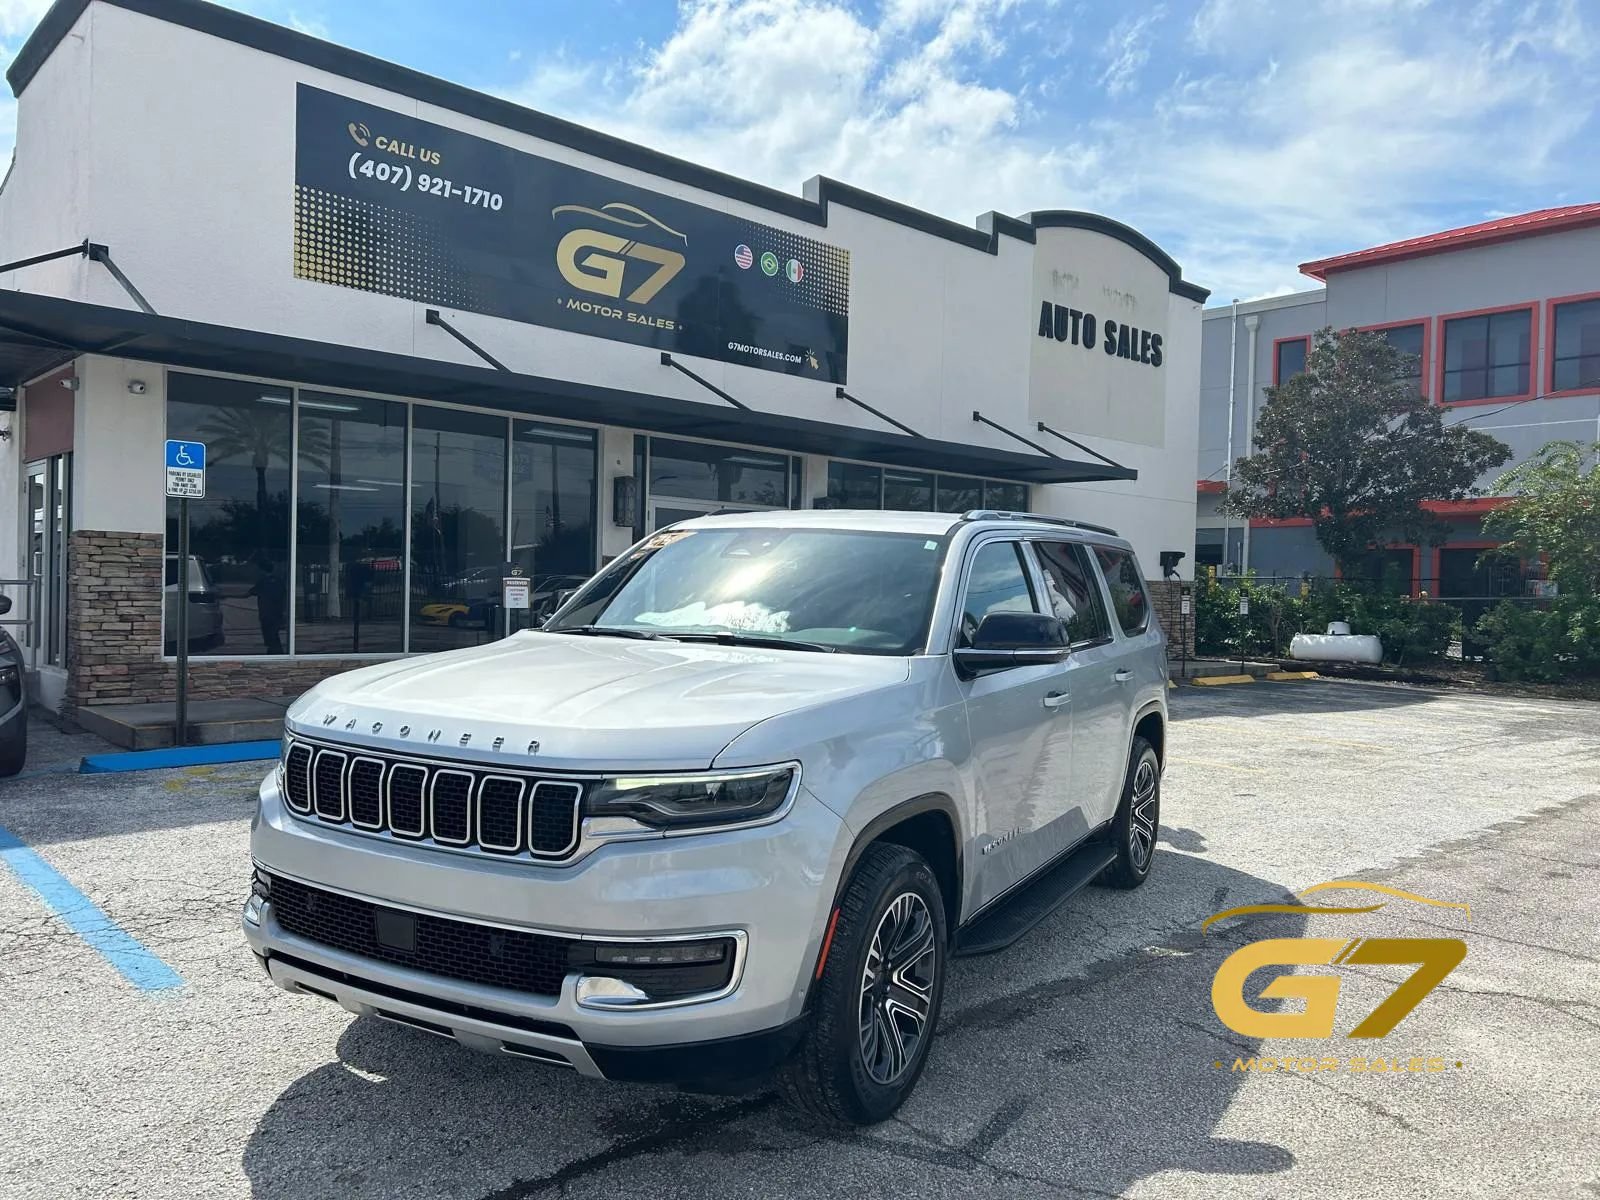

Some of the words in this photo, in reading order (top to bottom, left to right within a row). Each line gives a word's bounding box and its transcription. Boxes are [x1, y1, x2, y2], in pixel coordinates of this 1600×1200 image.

[375, 136, 416, 159] CALL
[419, 148, 441, 165] US
[348, 152, 412, 192] (407)
[417, 174, 503, 211] 921-1710
[556, 228, 686, 305] G7
[566, 298, 623, 320] MOTOR
[627, 312, 675, 330] SALES
[1038, 300, 1097, 350] AUTO
[1103, 319, 1163, 368] SALES
[727, 341, 802, 364] G7MOTORSALES.COM
[322, 714, 540, 755] WAGONEER
